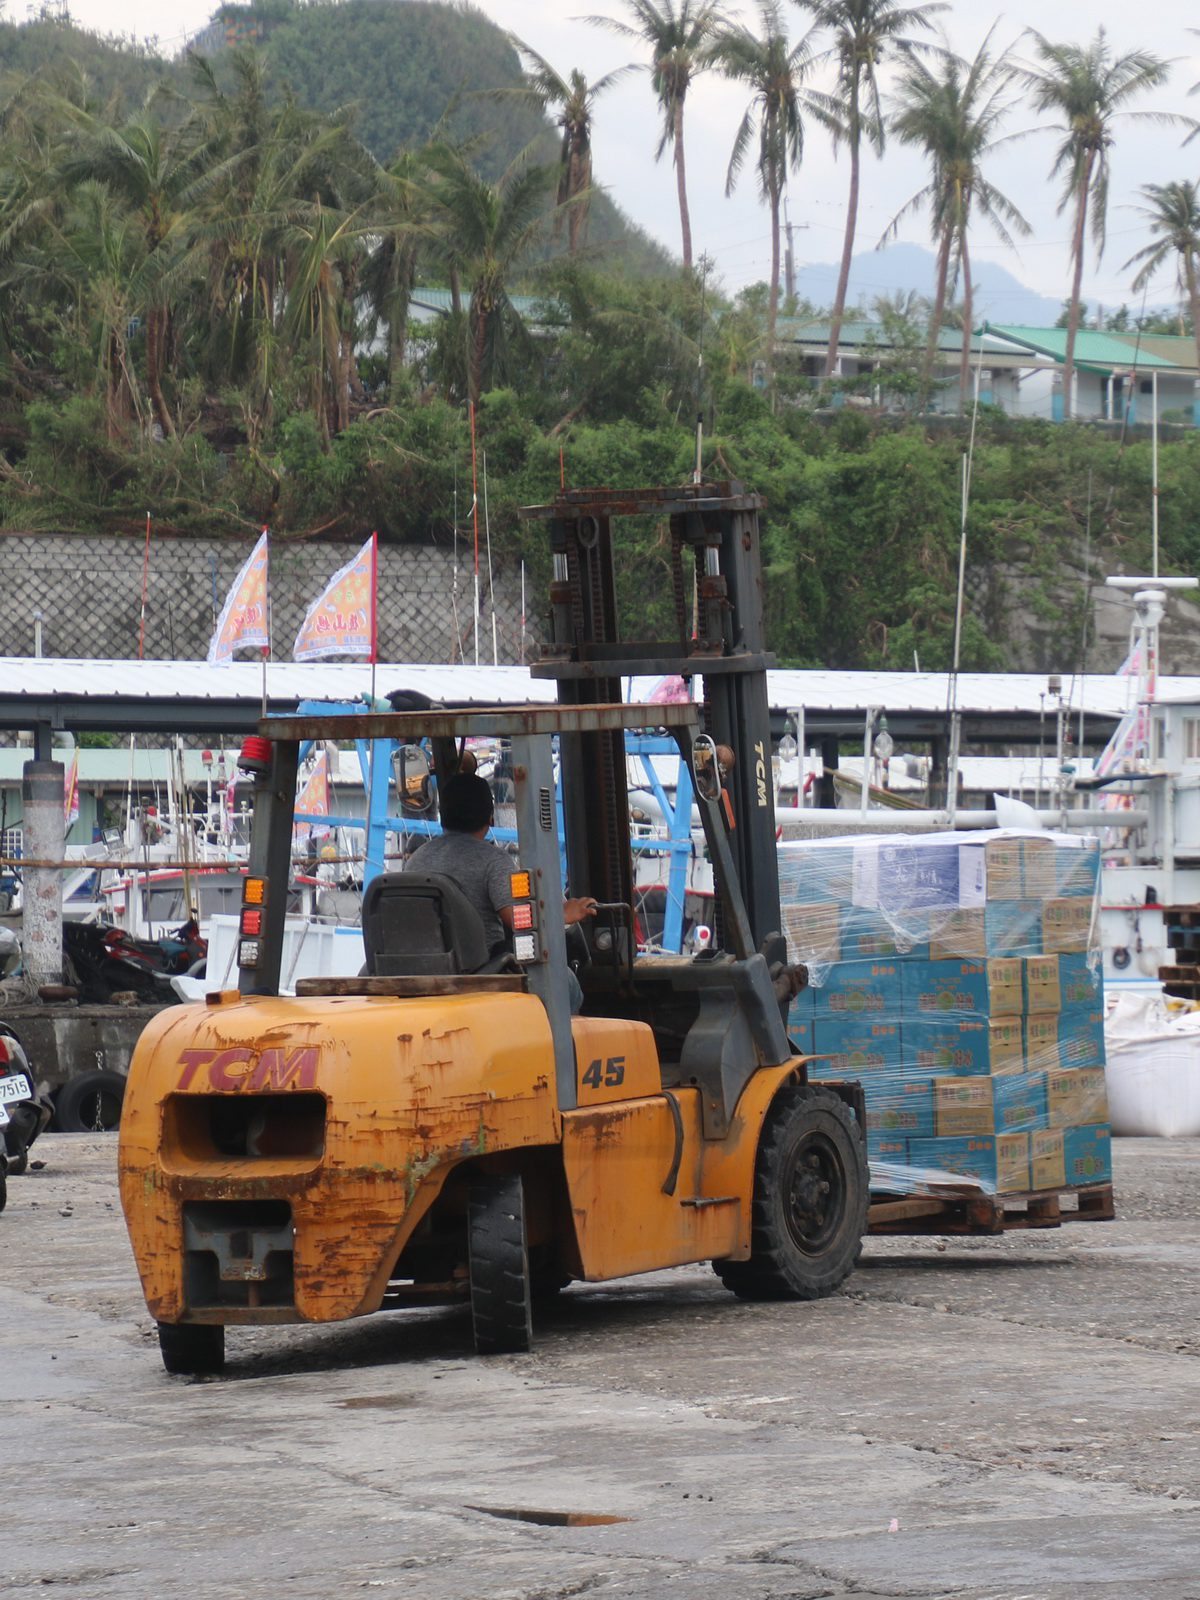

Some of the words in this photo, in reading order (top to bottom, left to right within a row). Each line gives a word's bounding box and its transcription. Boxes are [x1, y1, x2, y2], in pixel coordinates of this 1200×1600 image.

[754, 740, 768, 807] TCM
[176, 1047, 321, 1091] TCM
[582, 1056, 625, 1089] 45
